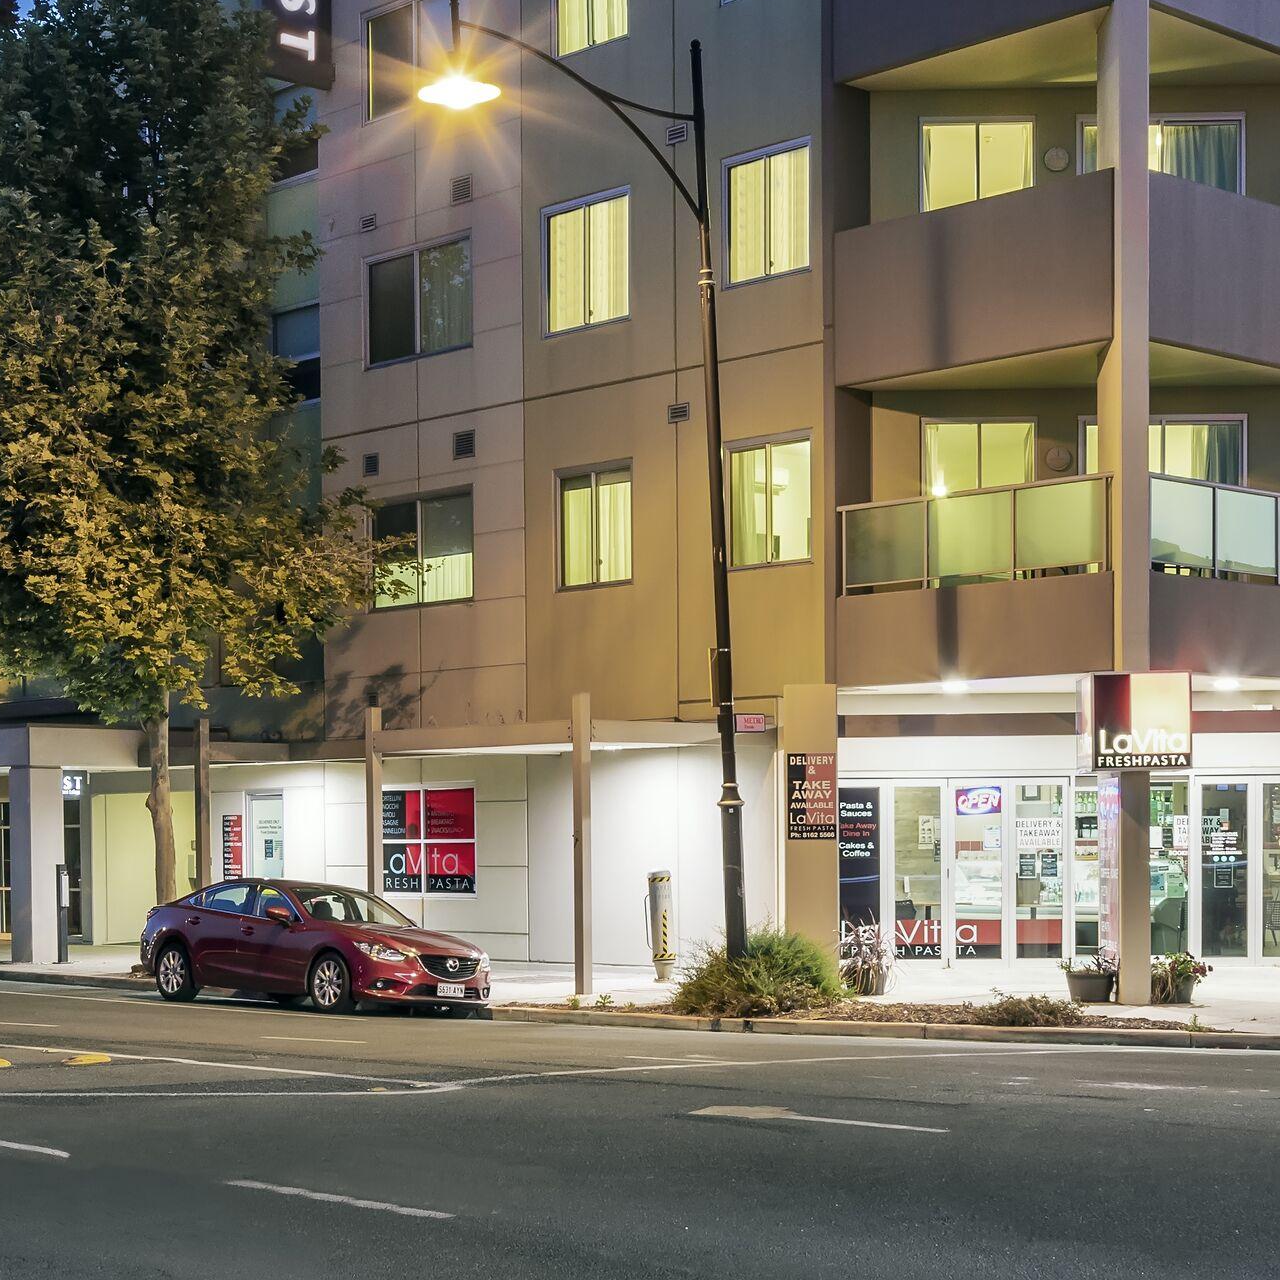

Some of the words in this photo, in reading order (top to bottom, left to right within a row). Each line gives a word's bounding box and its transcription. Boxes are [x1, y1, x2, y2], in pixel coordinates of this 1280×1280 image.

[1099, 728, 1188, 754] LaVita
[789, 756, 834, 765] DELIVERY
[807, 765, 816, 775] &
[792, 780, 831, 790] TAKE
[791, 790, 832, 800] AWAY
[958, 794, 1000, 810] OPEN
[789, 812, 835, 824] LaVita
[1019, 829, 1060, 837] TAKEAWAY
[1020, 838, 1060, 846] AVAILABLE
[382, 847, 459, 874] aVita
[385, 877, 419, 889] RESH
[429, 878, 470, 889] PASTA
